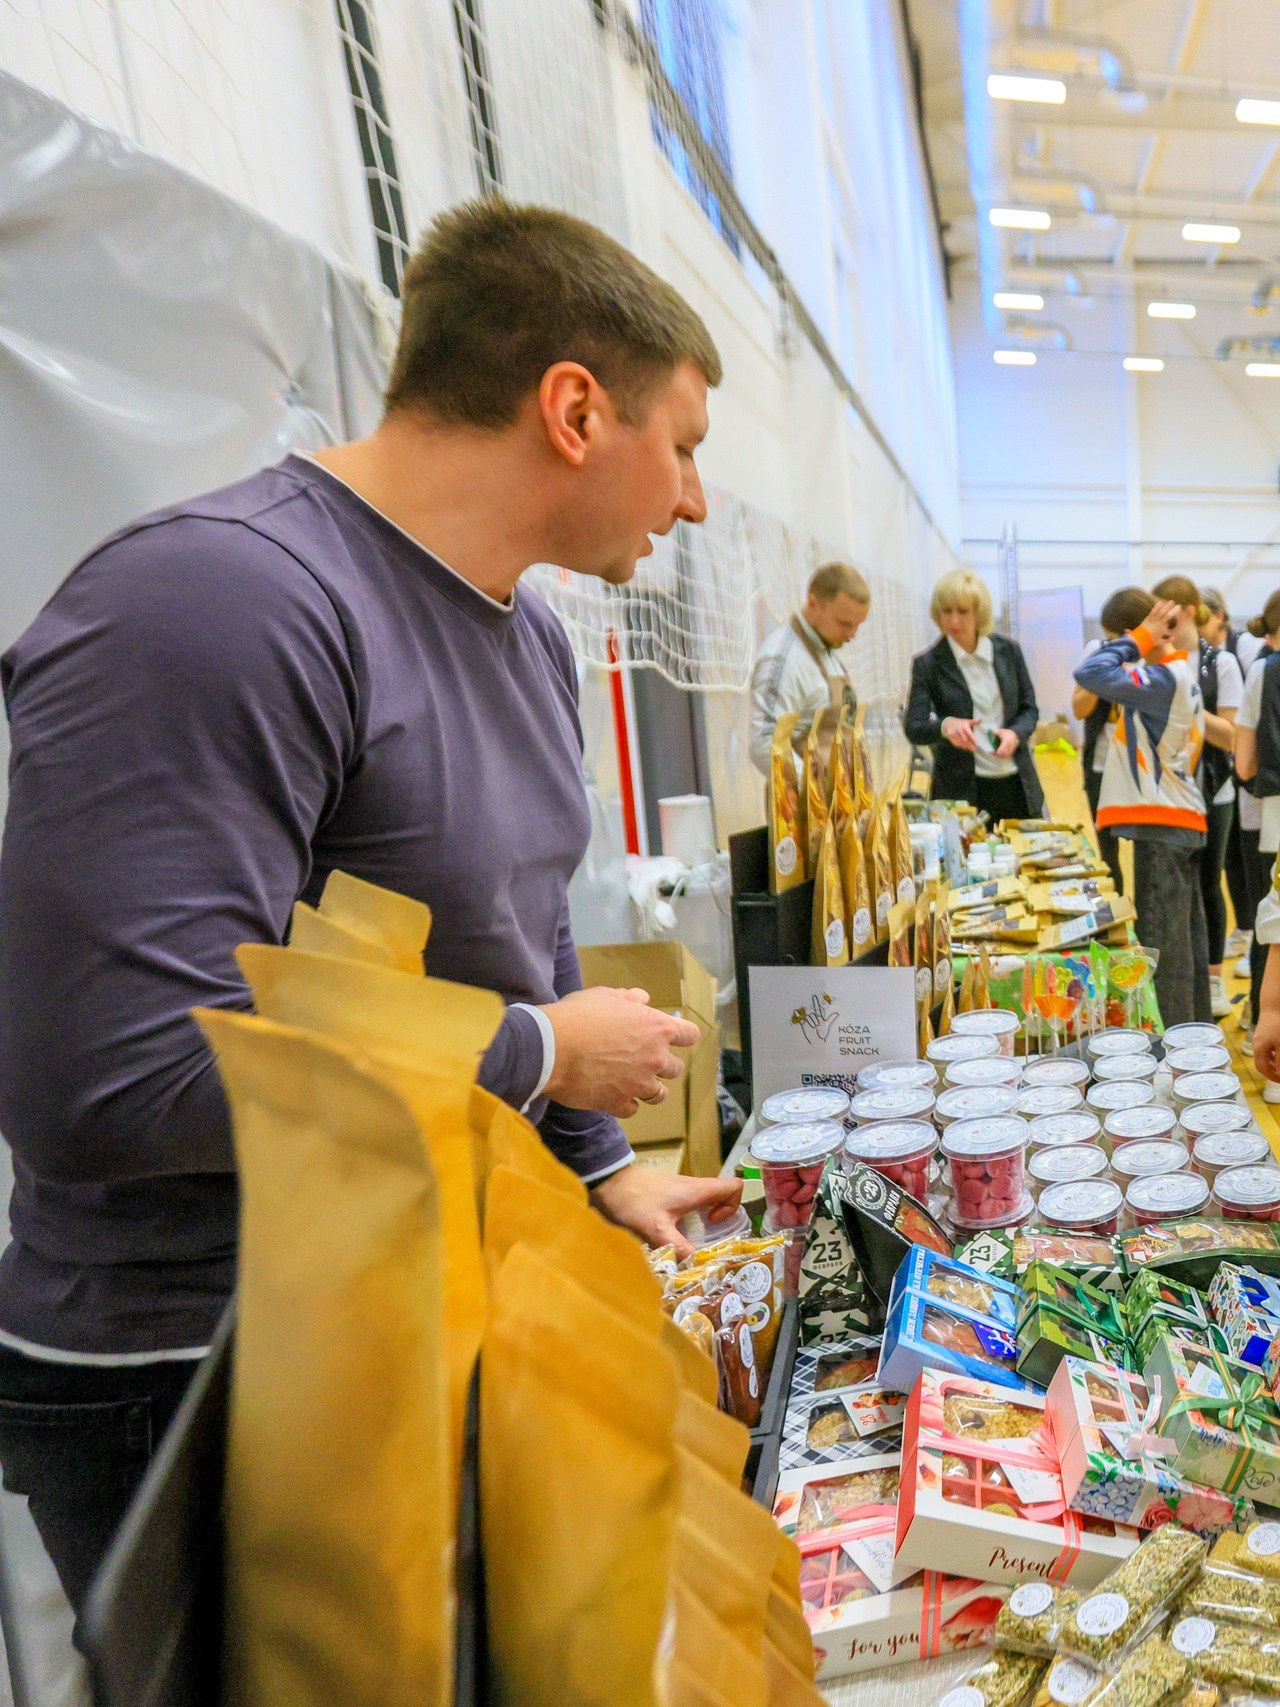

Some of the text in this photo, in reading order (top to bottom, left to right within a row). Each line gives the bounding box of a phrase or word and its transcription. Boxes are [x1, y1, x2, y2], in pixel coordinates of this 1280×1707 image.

[838, 1024, 871, 1034] KÓZA
[839, 1036, 871, 1045] FRUIT
[840, 1047, 880, 1056] SNACK
[812, 1241, 842, 1264] 23
[970, 1245, 990, 1264] 23
[887, 1633, 920, 1656] you
